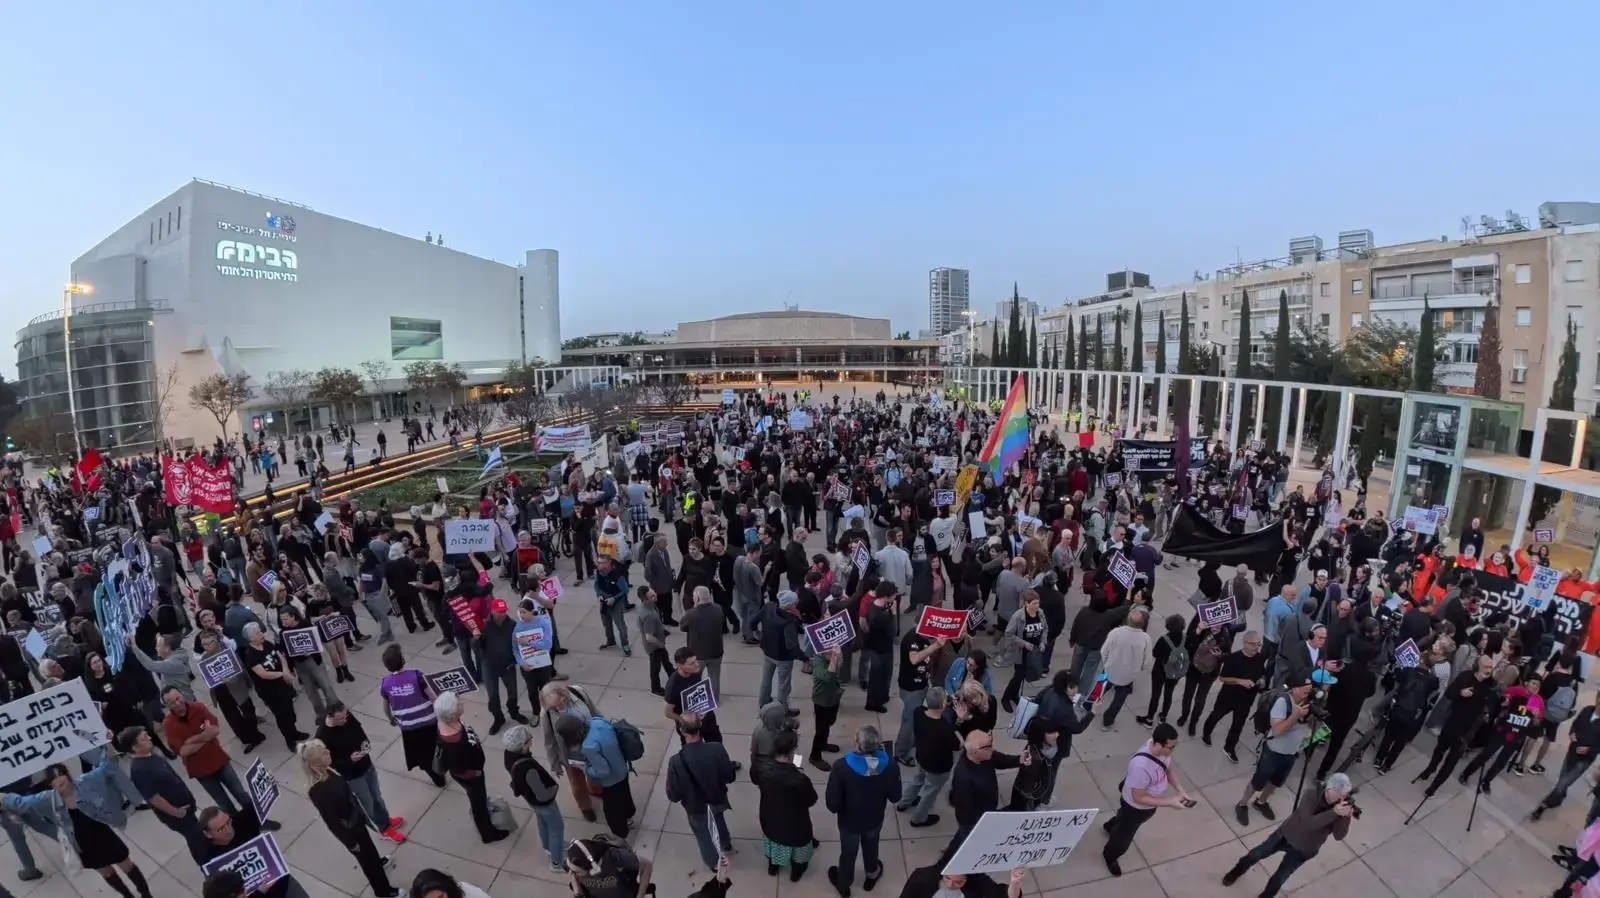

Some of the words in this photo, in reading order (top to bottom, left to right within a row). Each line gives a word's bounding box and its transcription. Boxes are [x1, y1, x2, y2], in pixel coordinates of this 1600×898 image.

[258, 228, 271, 238] תל
[216, 264, 254, 279] הלאומי
[255, 269, 298, 282] התיאטרון
[461, 523, 490, 533] אהבה
[25, 691, 74, 721] כיפת
[1064, 811, 1090, 828] לא
